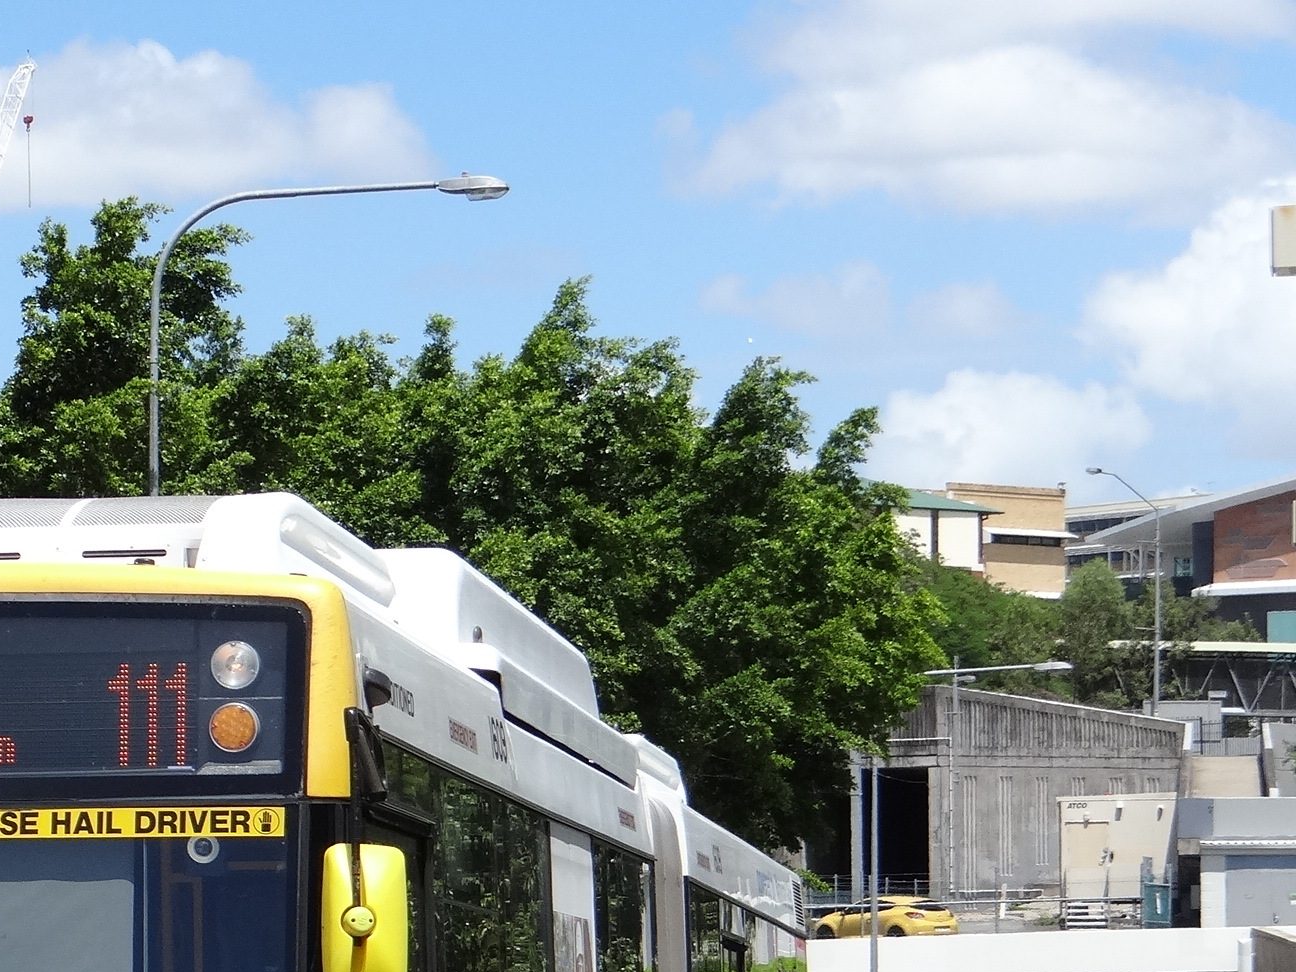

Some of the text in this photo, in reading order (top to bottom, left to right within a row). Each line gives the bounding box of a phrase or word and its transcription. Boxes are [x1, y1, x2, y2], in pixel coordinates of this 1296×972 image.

[107, 662, 189, 768] 111
[1066, 802, 1088, 810] ATCO
[51, 811, 123, 836] HAIL
[134, 810, 251, 835] DRIVER
